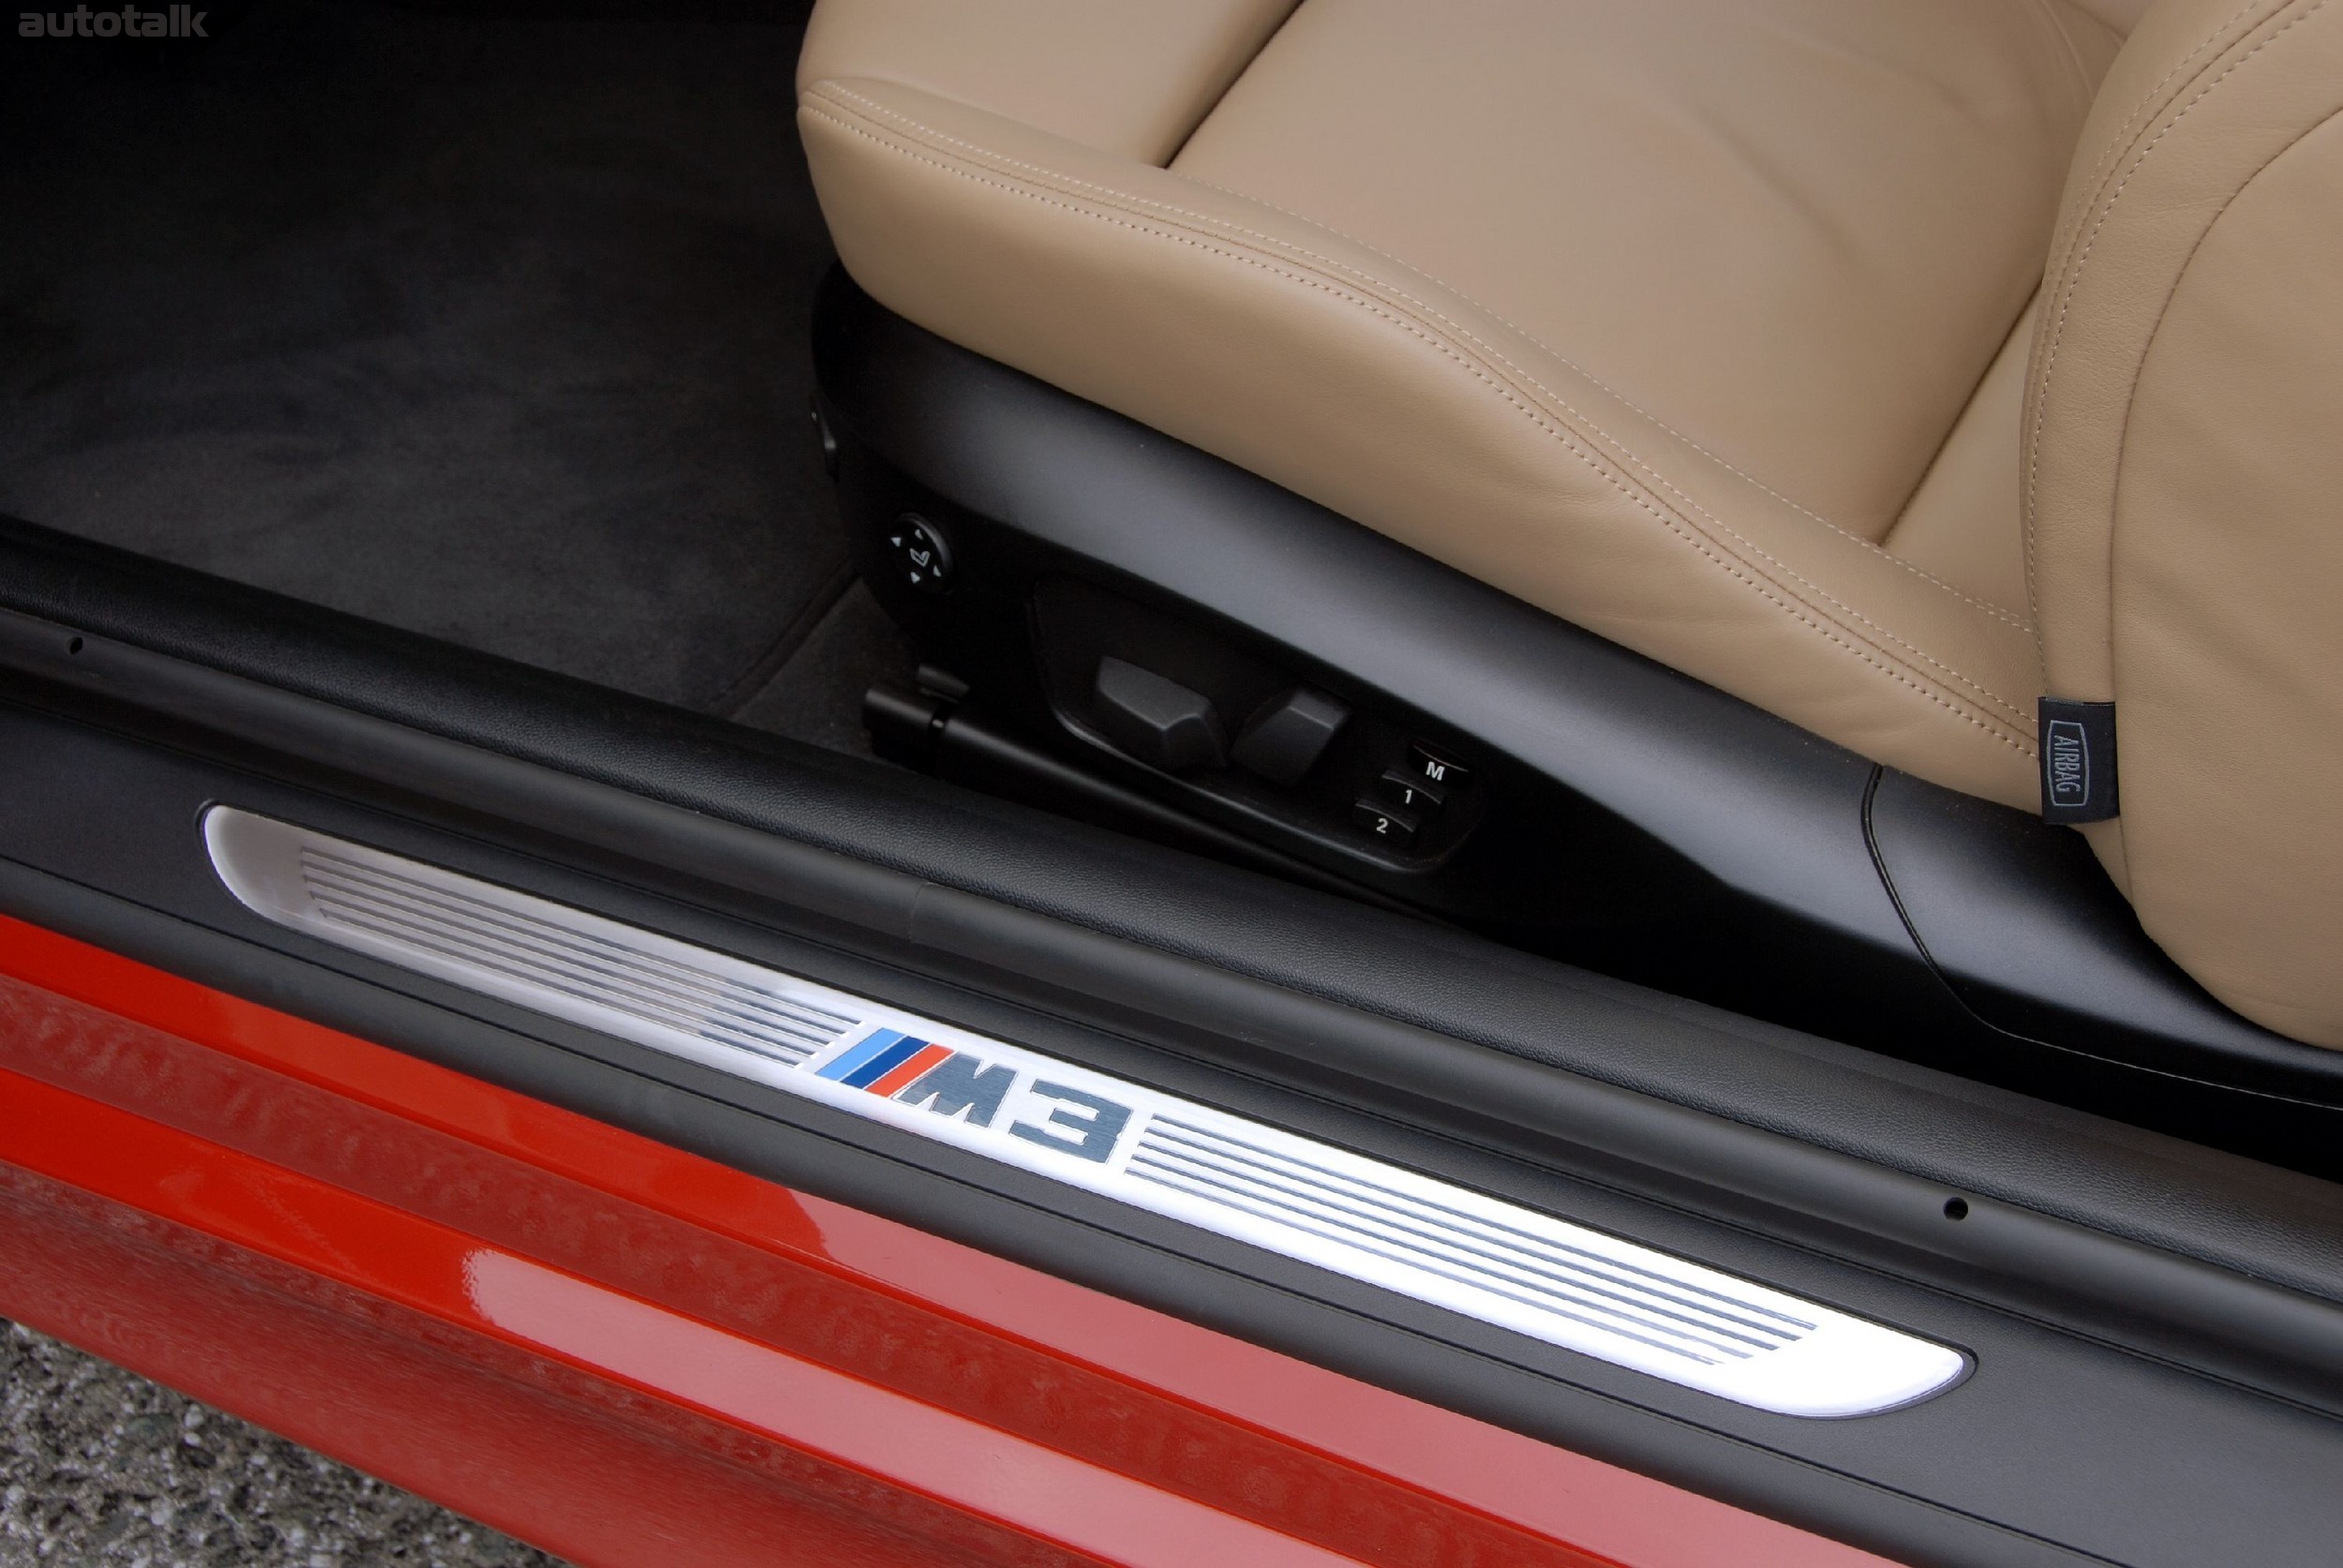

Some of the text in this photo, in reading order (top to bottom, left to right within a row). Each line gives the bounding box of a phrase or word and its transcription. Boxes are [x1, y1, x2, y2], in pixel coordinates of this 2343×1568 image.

[1425, 761, 1445, 782] M
[2053, 735, 2081, 793] AIRBAG
[1405, 789, 1412, 804] 1
[1376, 817, 1389, 834] 2
[891, 1050, 1133, 1165] M3
